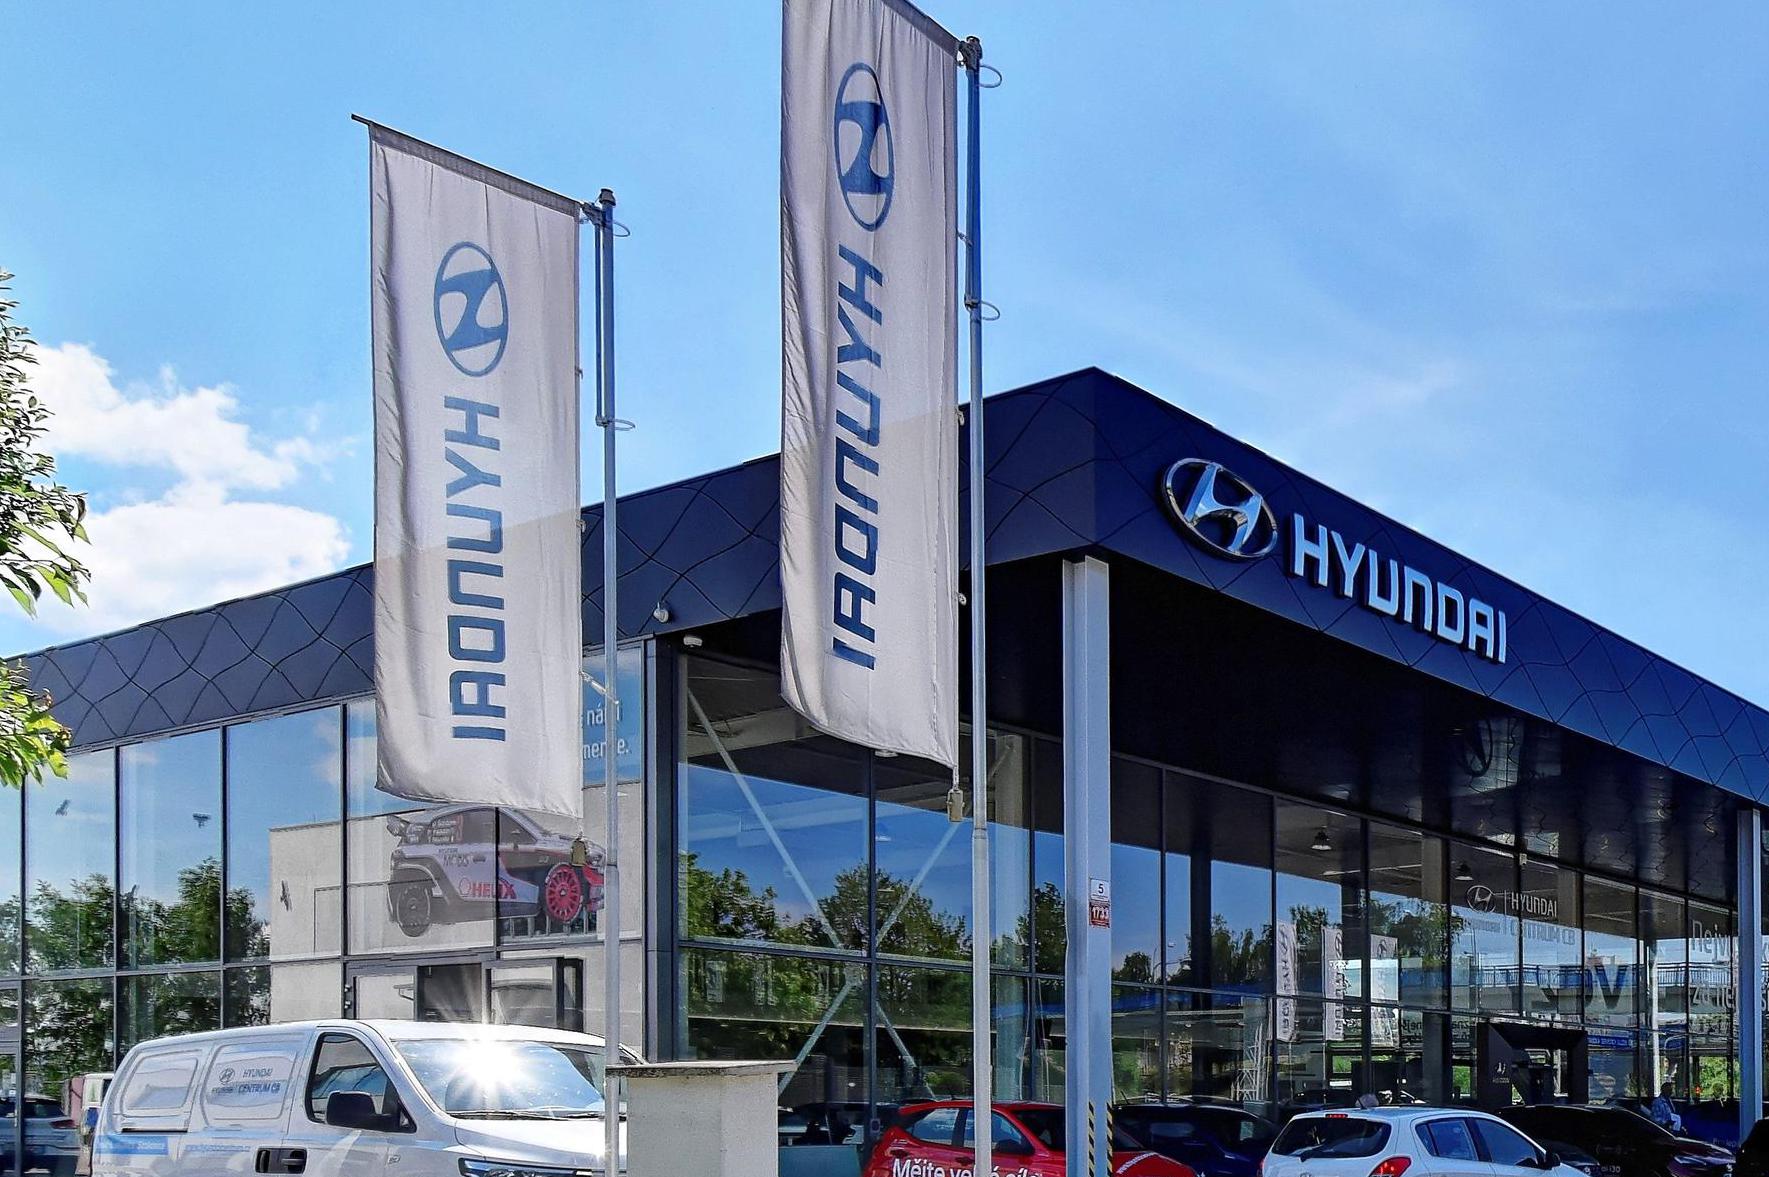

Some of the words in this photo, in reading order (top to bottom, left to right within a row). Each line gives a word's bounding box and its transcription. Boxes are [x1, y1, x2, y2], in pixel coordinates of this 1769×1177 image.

[1293, 513, 1507, 664] HYUNDAI
[473, 882, 517, 899] HELX
[1098, 884, 1104, 893] 5
[1511, 892, 1557, 918] HYUNDAI
